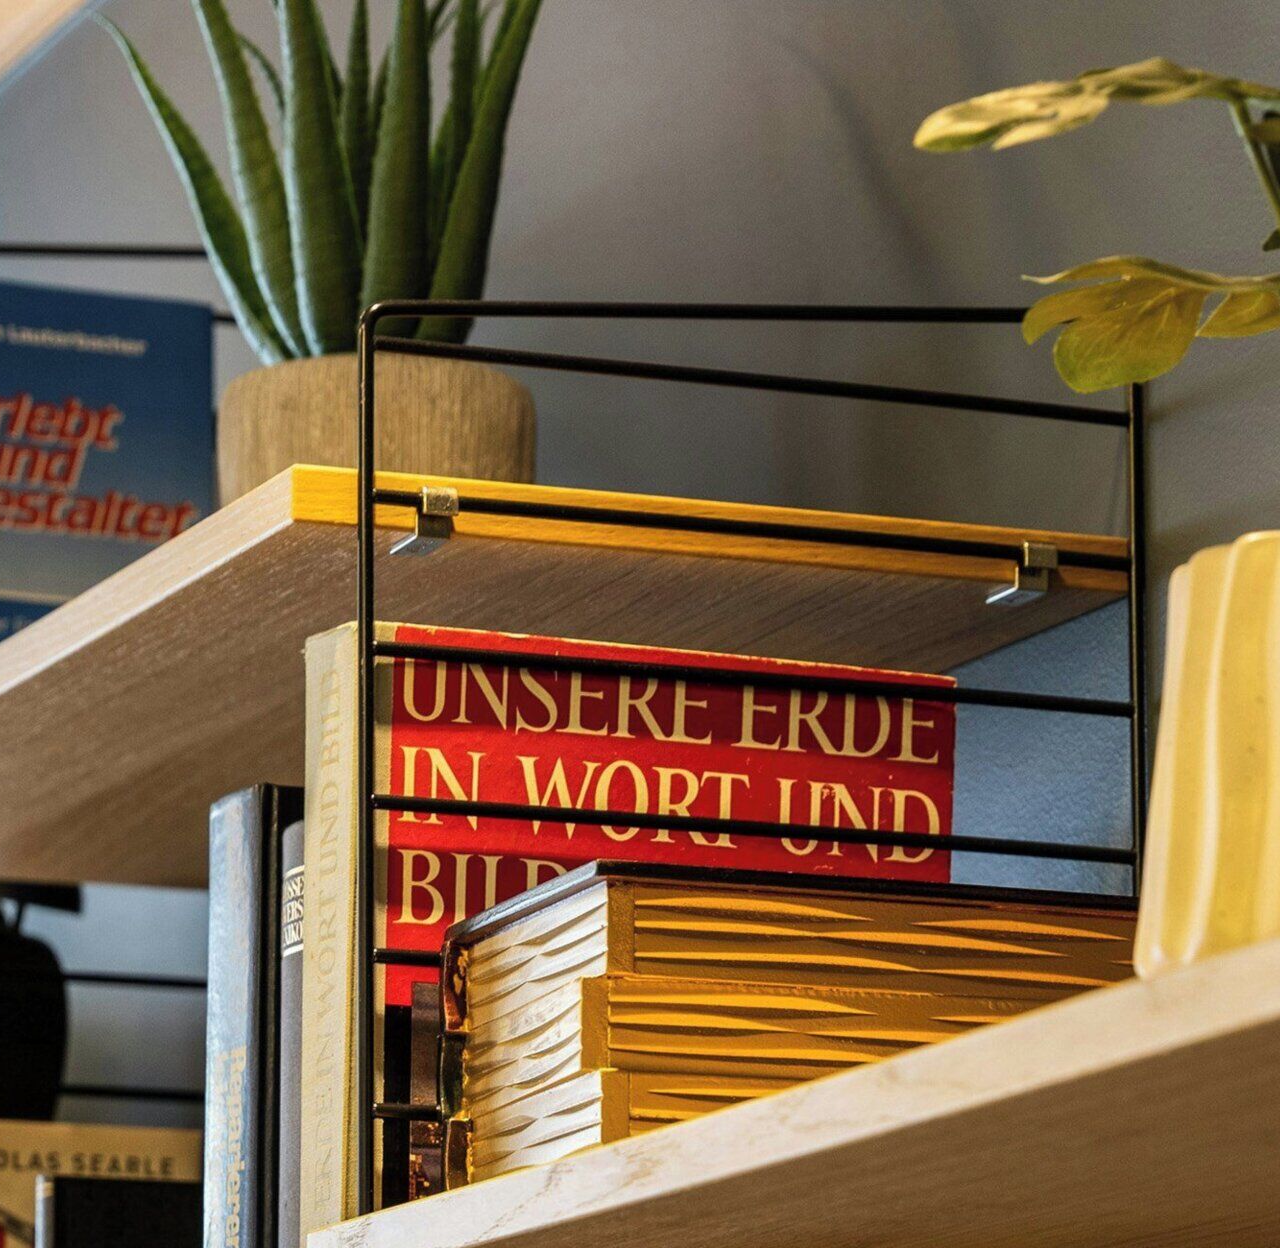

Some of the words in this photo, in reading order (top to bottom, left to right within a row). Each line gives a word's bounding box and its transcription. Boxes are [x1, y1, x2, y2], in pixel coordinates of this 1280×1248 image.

[399, 657, 713, 745] UNSERE
[731, 680, 940, 765] ERDE
[396, 745, 488, 832] IN
[515, 755, 751, 849] WORT
[775, 777, 943, 865] UND
